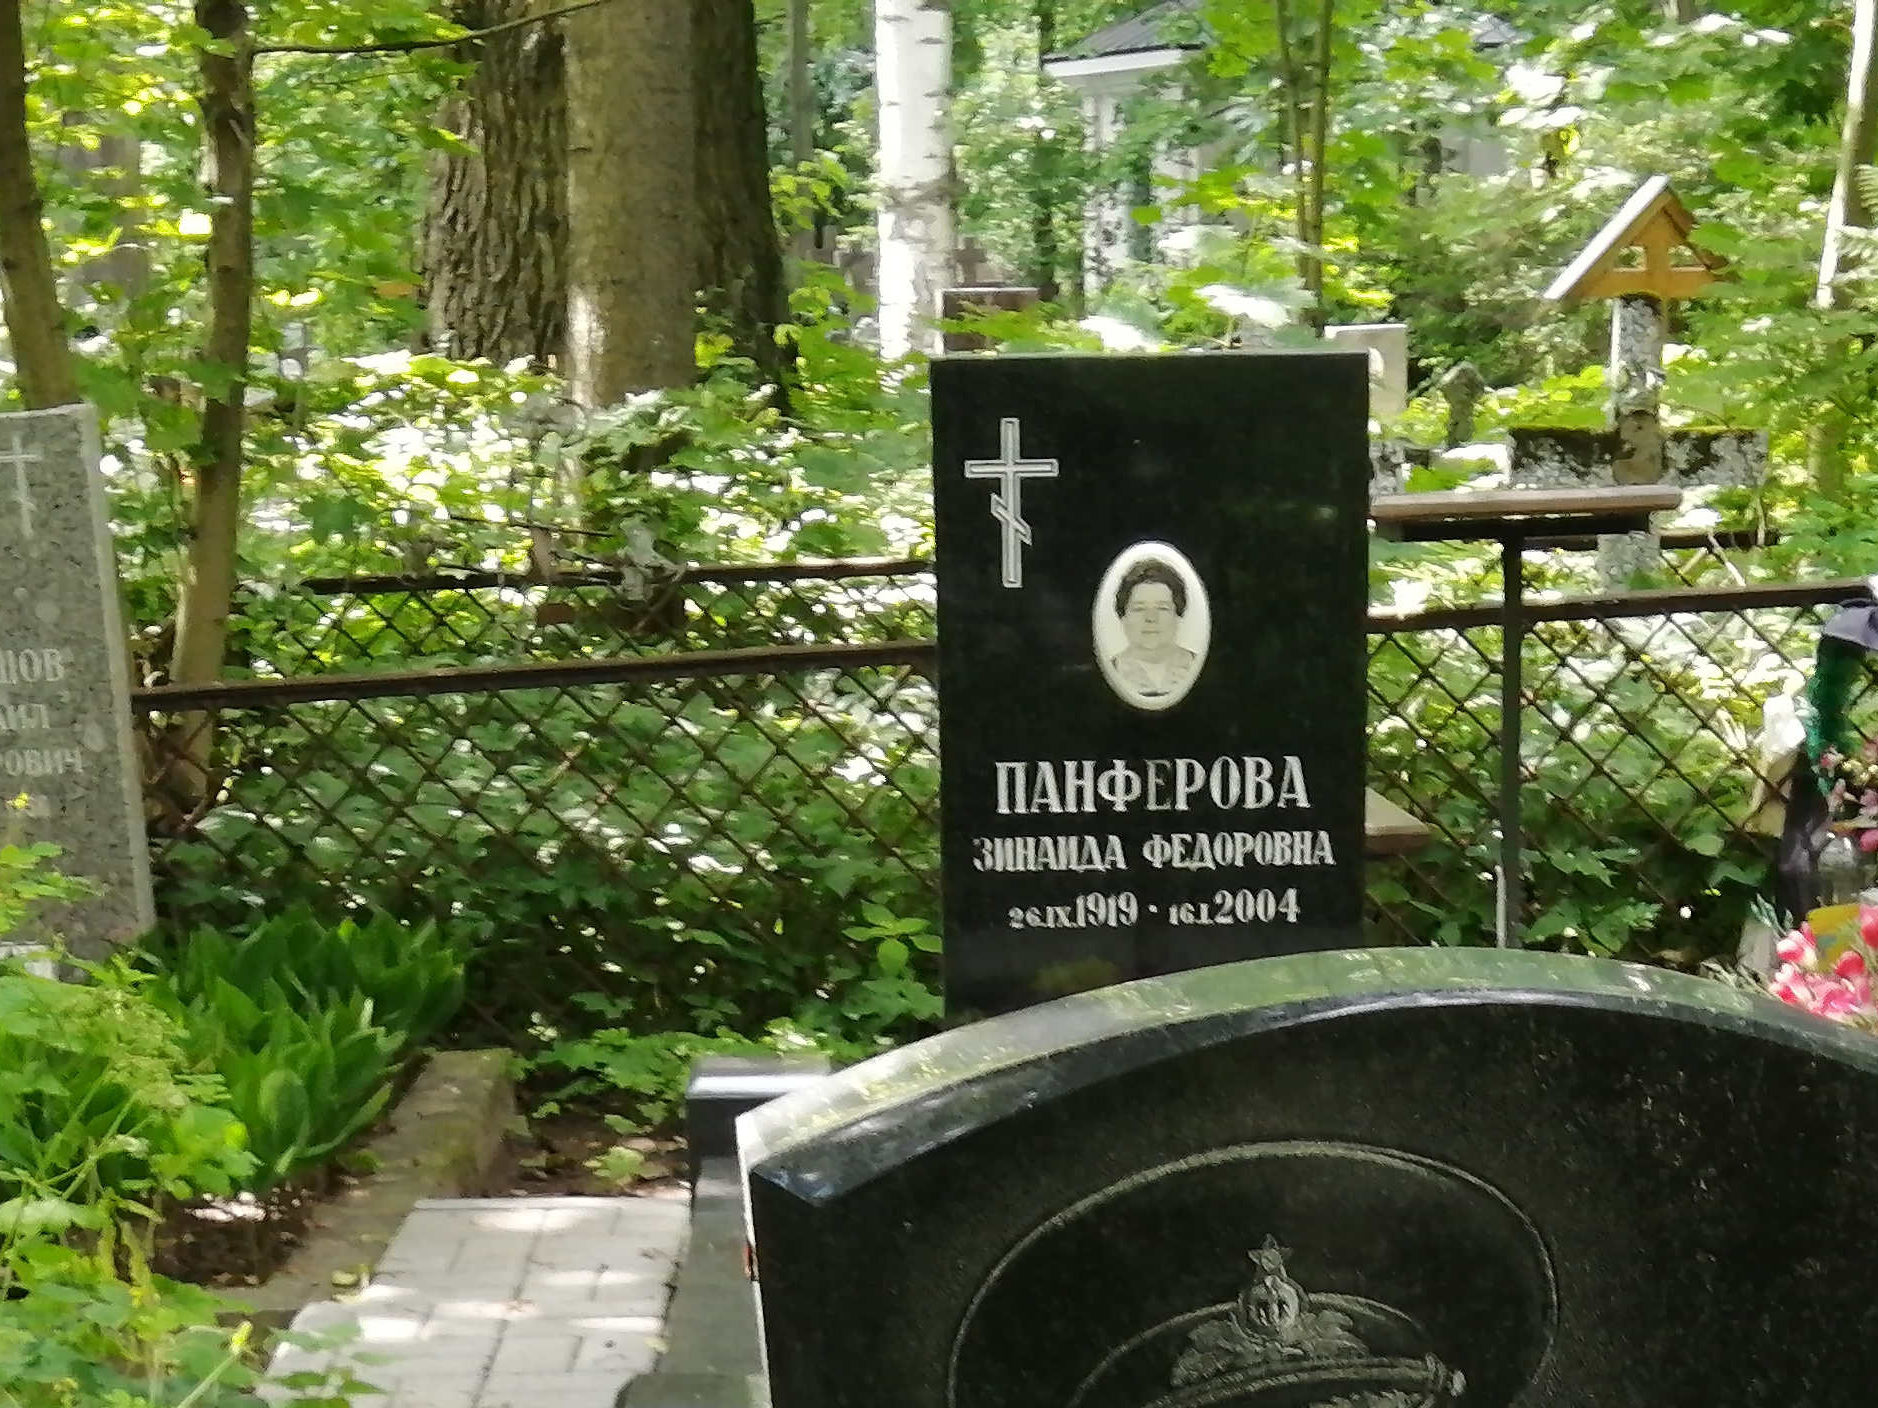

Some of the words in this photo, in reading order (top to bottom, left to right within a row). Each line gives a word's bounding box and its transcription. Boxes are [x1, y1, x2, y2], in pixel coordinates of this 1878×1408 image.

[994, 755, 1312, 815] ПАНФЕРОВА
[972, 834, 1128, 874] ЗИНАИДА
[1142, 830, 1336, 872] ФЕДОРОВНА
